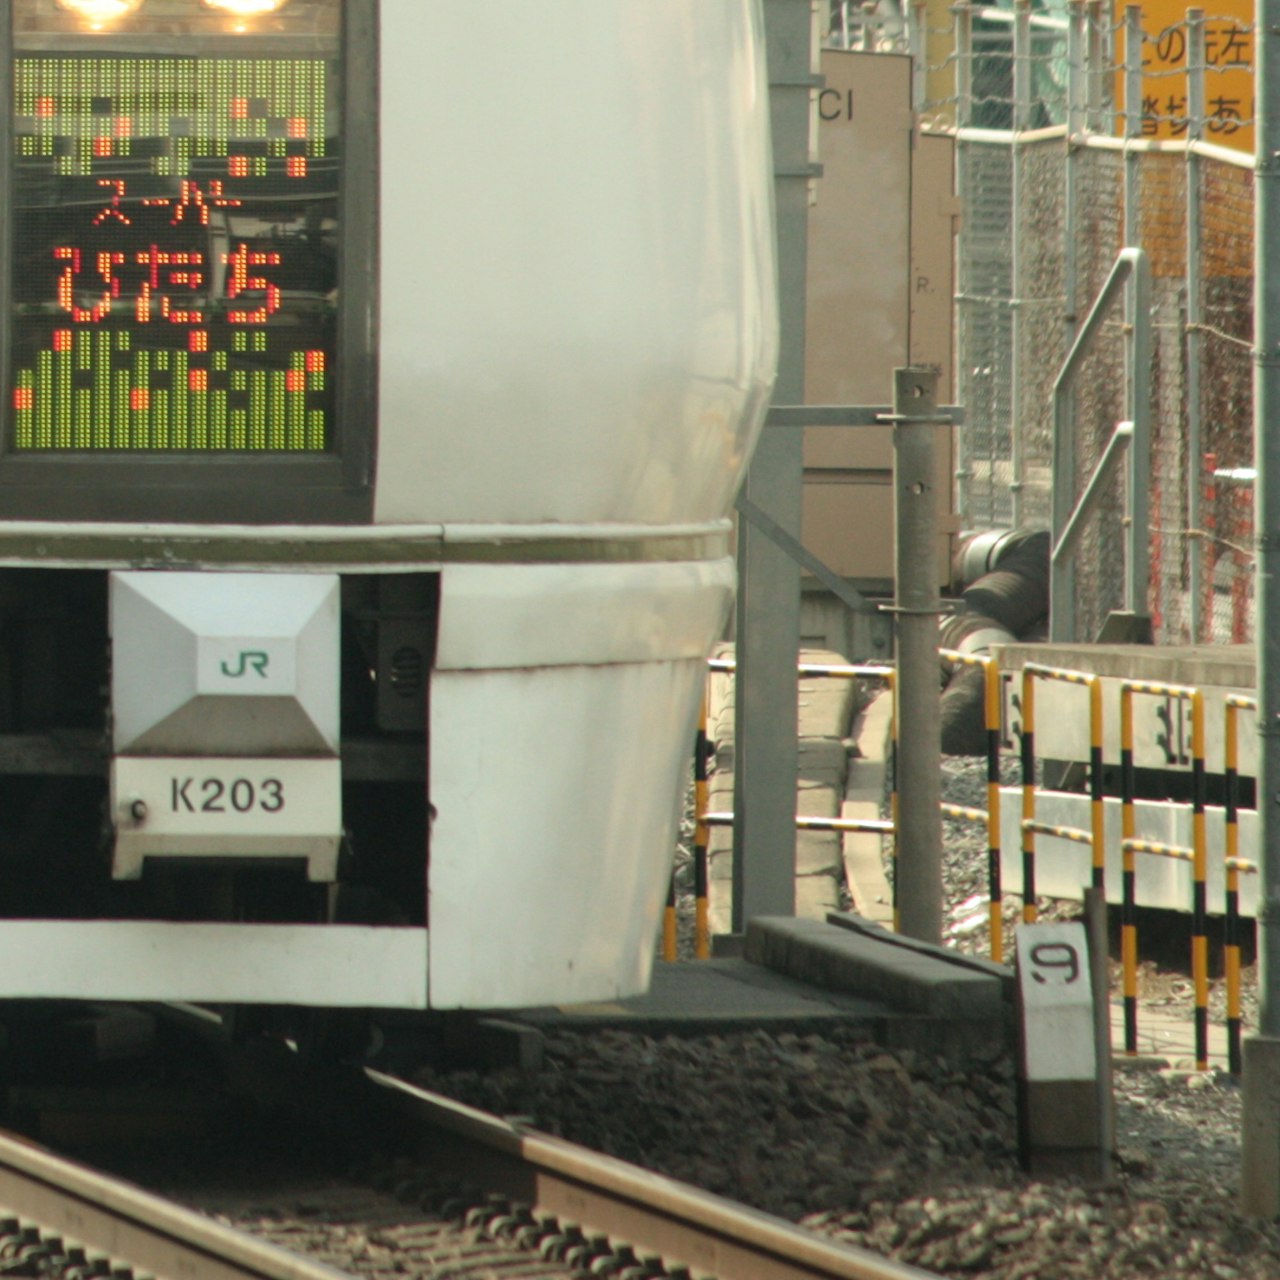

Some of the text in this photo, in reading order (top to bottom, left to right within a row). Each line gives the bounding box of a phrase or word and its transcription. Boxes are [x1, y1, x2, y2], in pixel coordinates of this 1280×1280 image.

[93, 179, 242, 224] スーパー
[53, 243, 281, 322] ひたち
[220, 651, 269, 678] JR
[171, 777, 285, 813] K203
